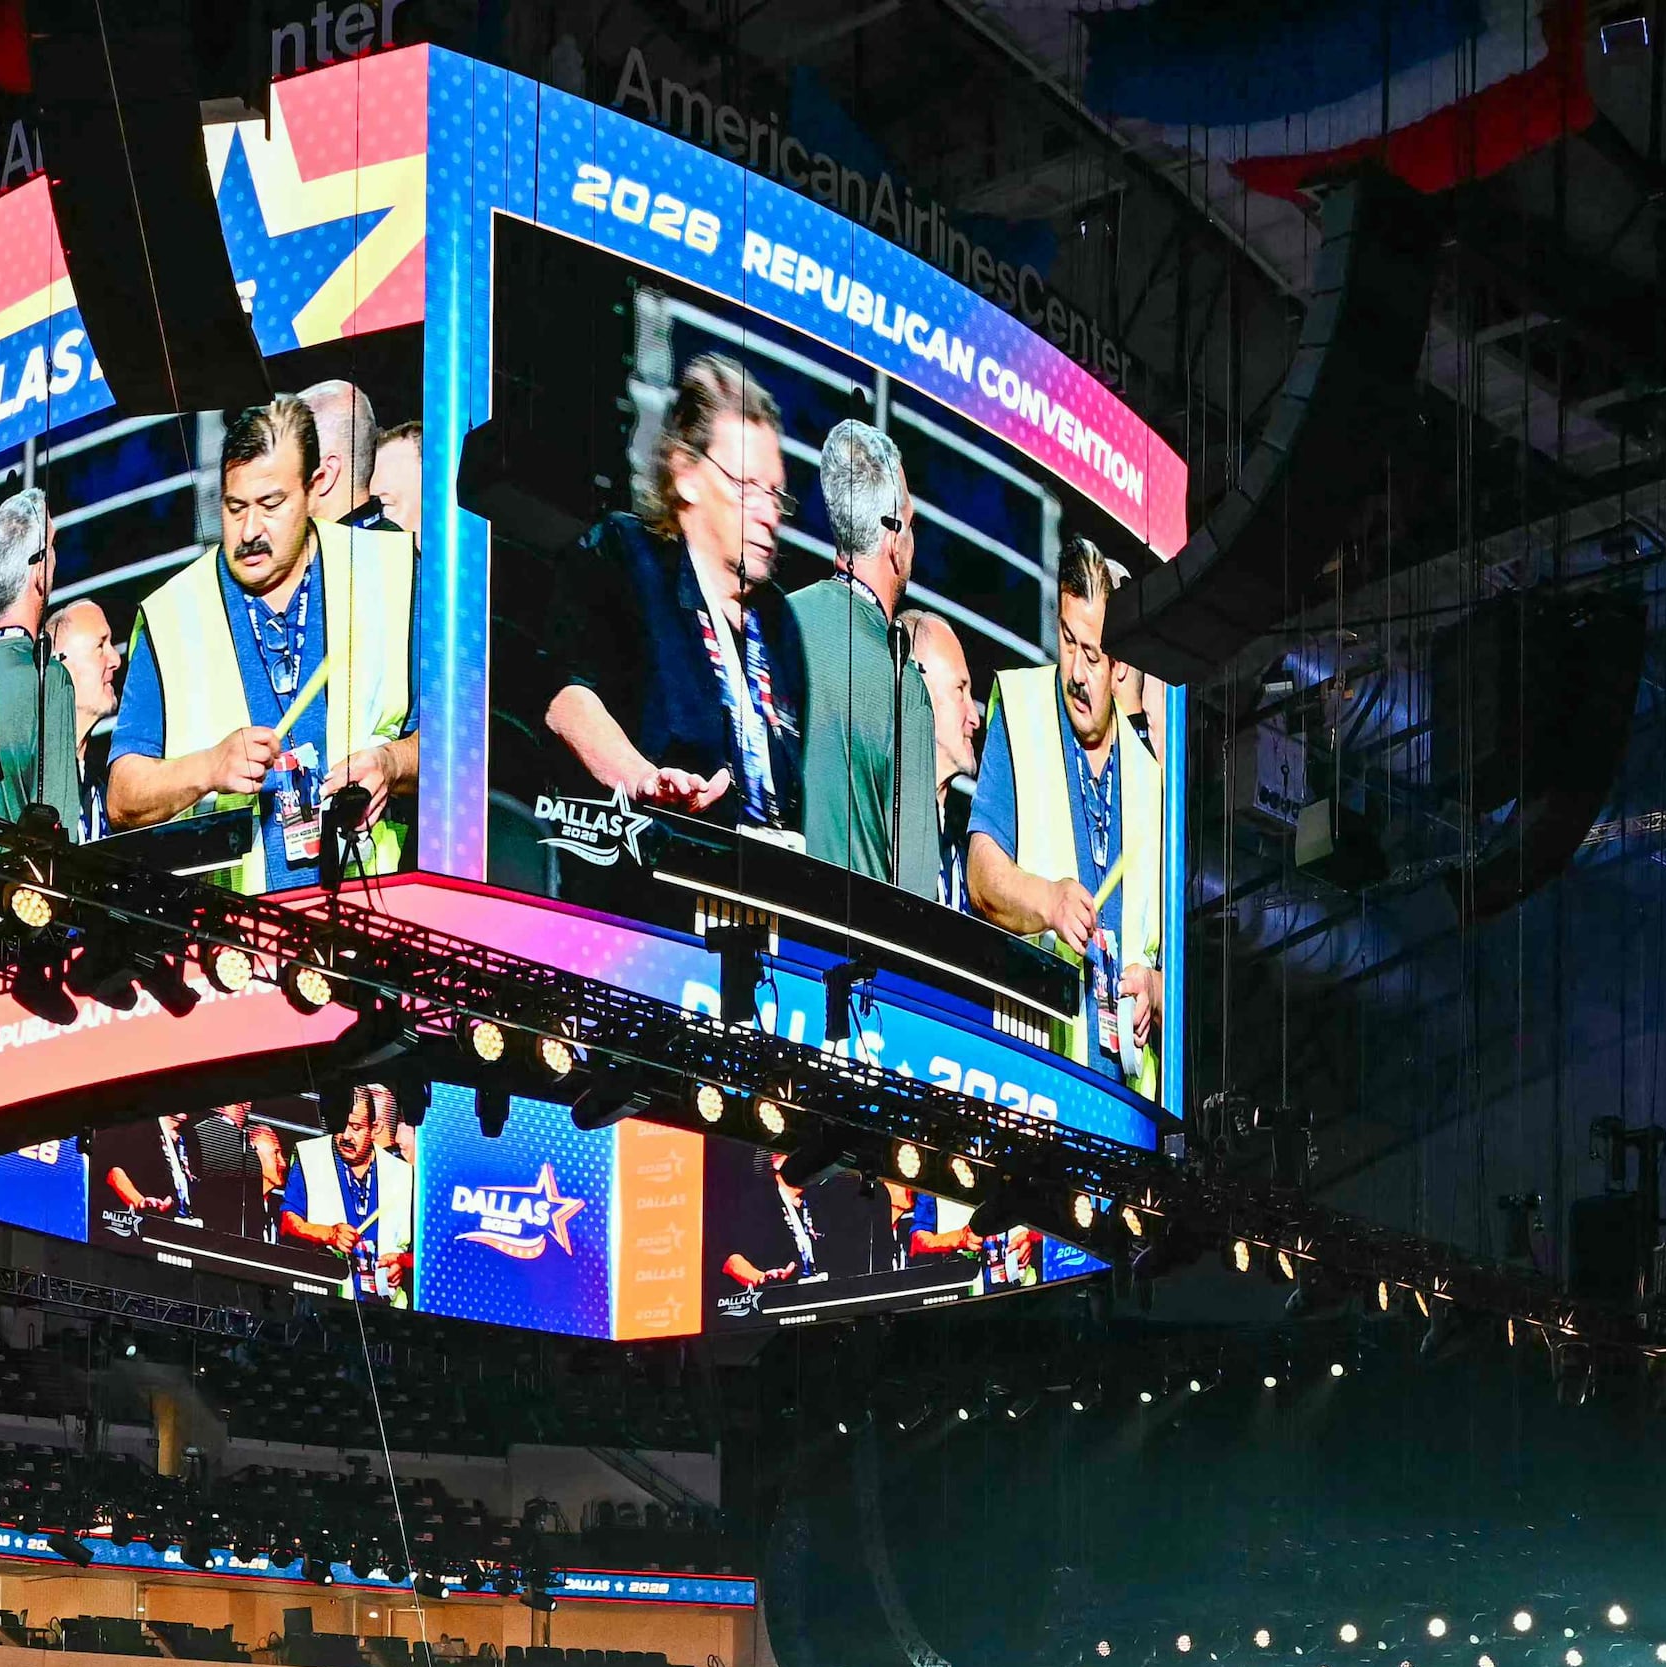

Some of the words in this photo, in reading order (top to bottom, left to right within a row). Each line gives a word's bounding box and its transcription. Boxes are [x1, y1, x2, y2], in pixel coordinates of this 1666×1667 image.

[571, 163, 721, 256] 2026
[742, 230, 976, 384] REPUBLICAN
[977, 357, 1144, 508] CONVENTION
[534, 794, 625, 838] DALLAS
[102, 1210, 133, 1226] DALLAS
[451, 1185, 551, 1227] DALLAS
[717, 1295, 752, 1308] DALLAS
[564, 1578, 611, 1593] DALLAS
